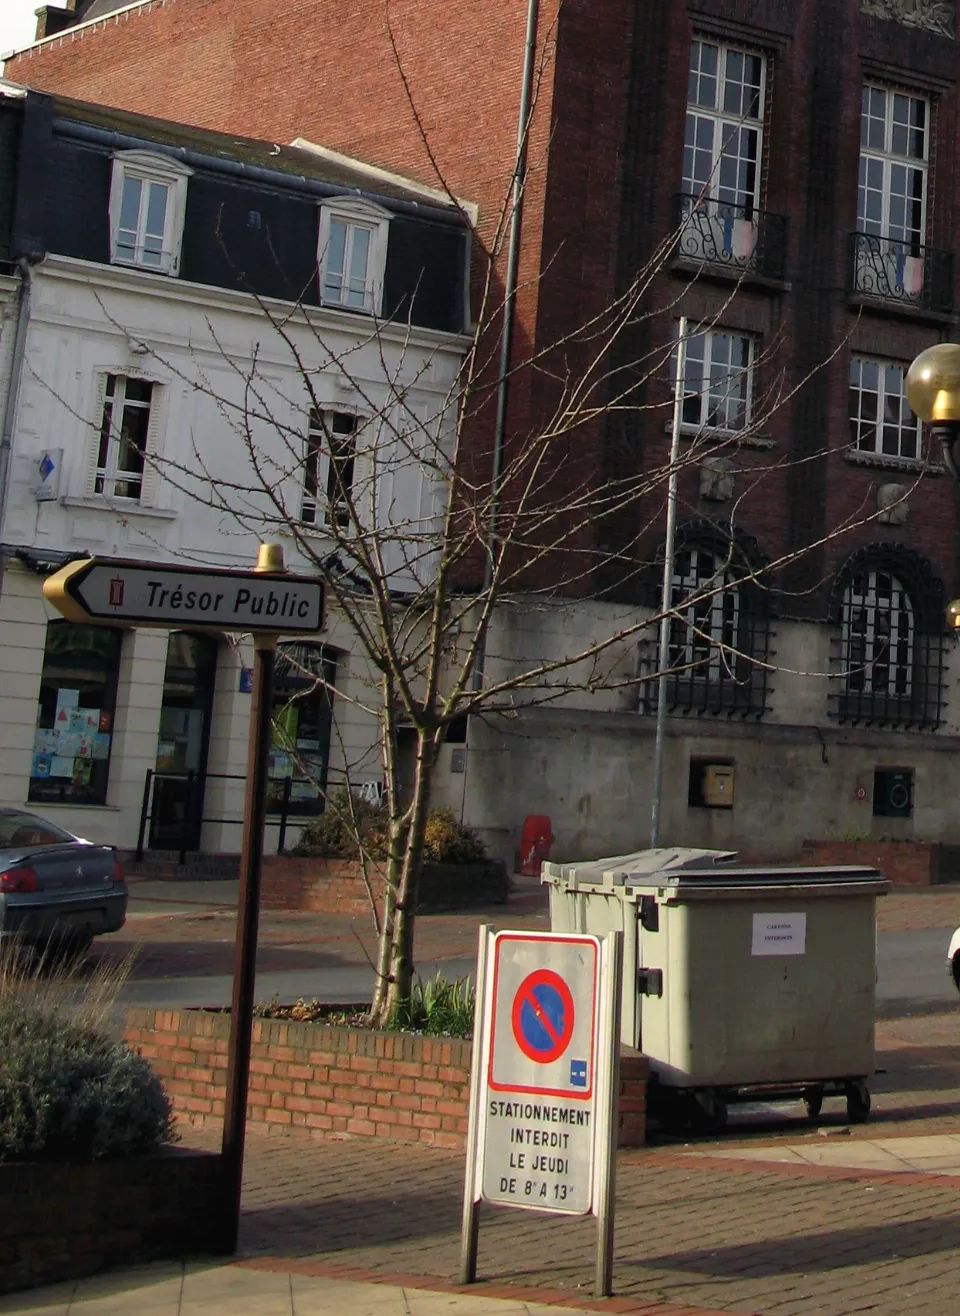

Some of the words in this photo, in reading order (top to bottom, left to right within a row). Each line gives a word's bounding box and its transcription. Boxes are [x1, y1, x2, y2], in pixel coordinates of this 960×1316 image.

[147, 581, 224, 611] Trésor
[233, 588, 310, 618] Public
[490, 1100, 591, 1126] STATIONNEMENT
[510, 1127, 570, 1149] INTERDIT
[509, 1152, 526, 1169] LE
[532, 1155, 569, 1174] JEUDI
[500, 1177, 517, 1194] DE
[539, 1182, 547, 1197] A
